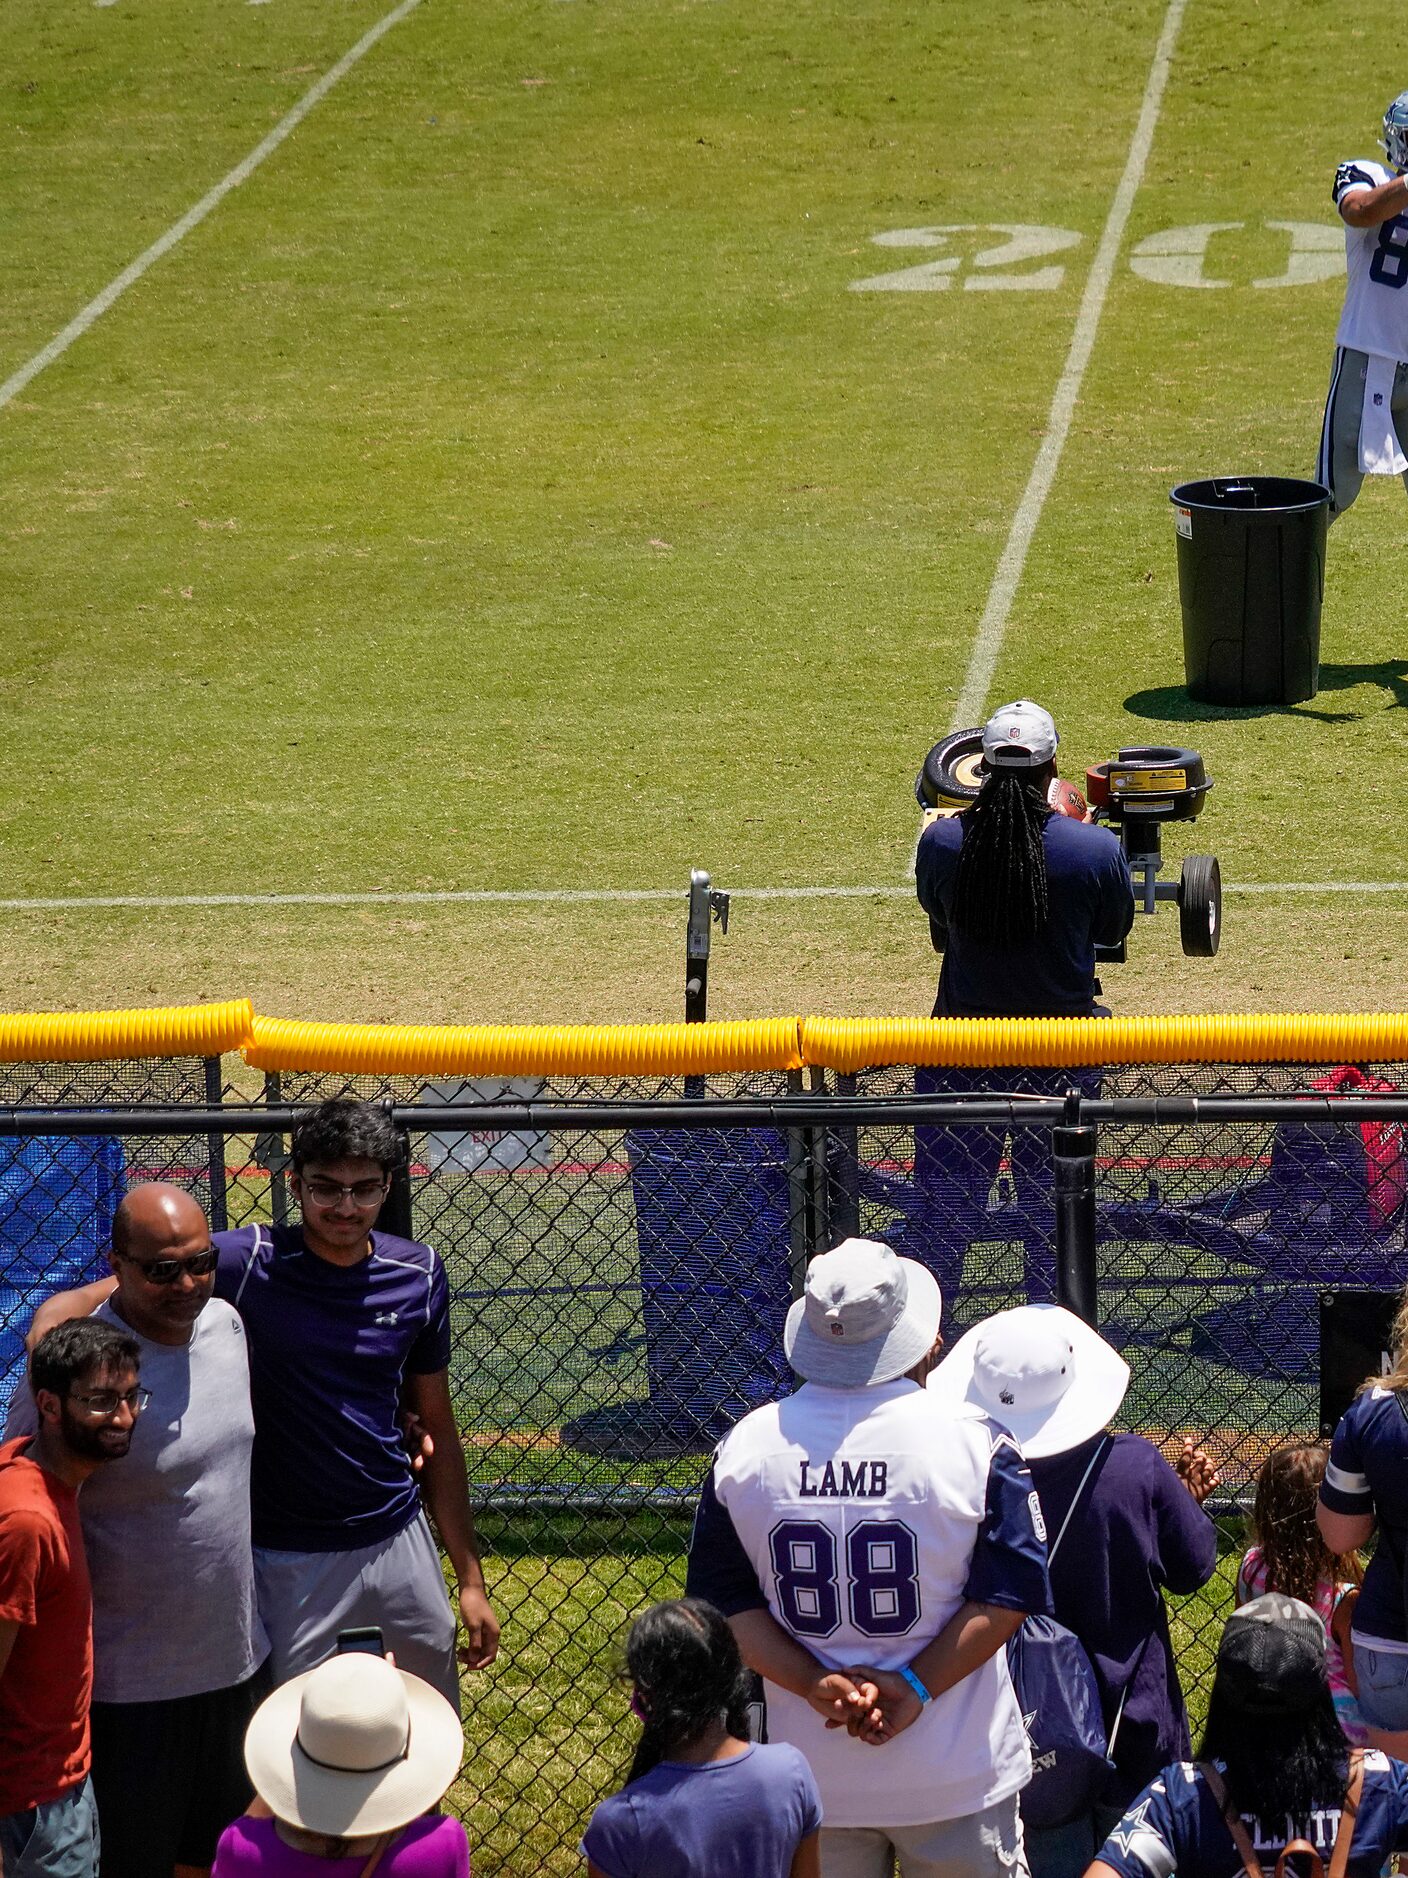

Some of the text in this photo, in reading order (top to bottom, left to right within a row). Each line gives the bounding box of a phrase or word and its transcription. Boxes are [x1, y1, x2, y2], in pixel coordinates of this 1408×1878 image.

[847, 222, 1347, 291] 20
[799, 1460, 888, 1497] LAMB
[768, 1518, 922, 1639] 88
